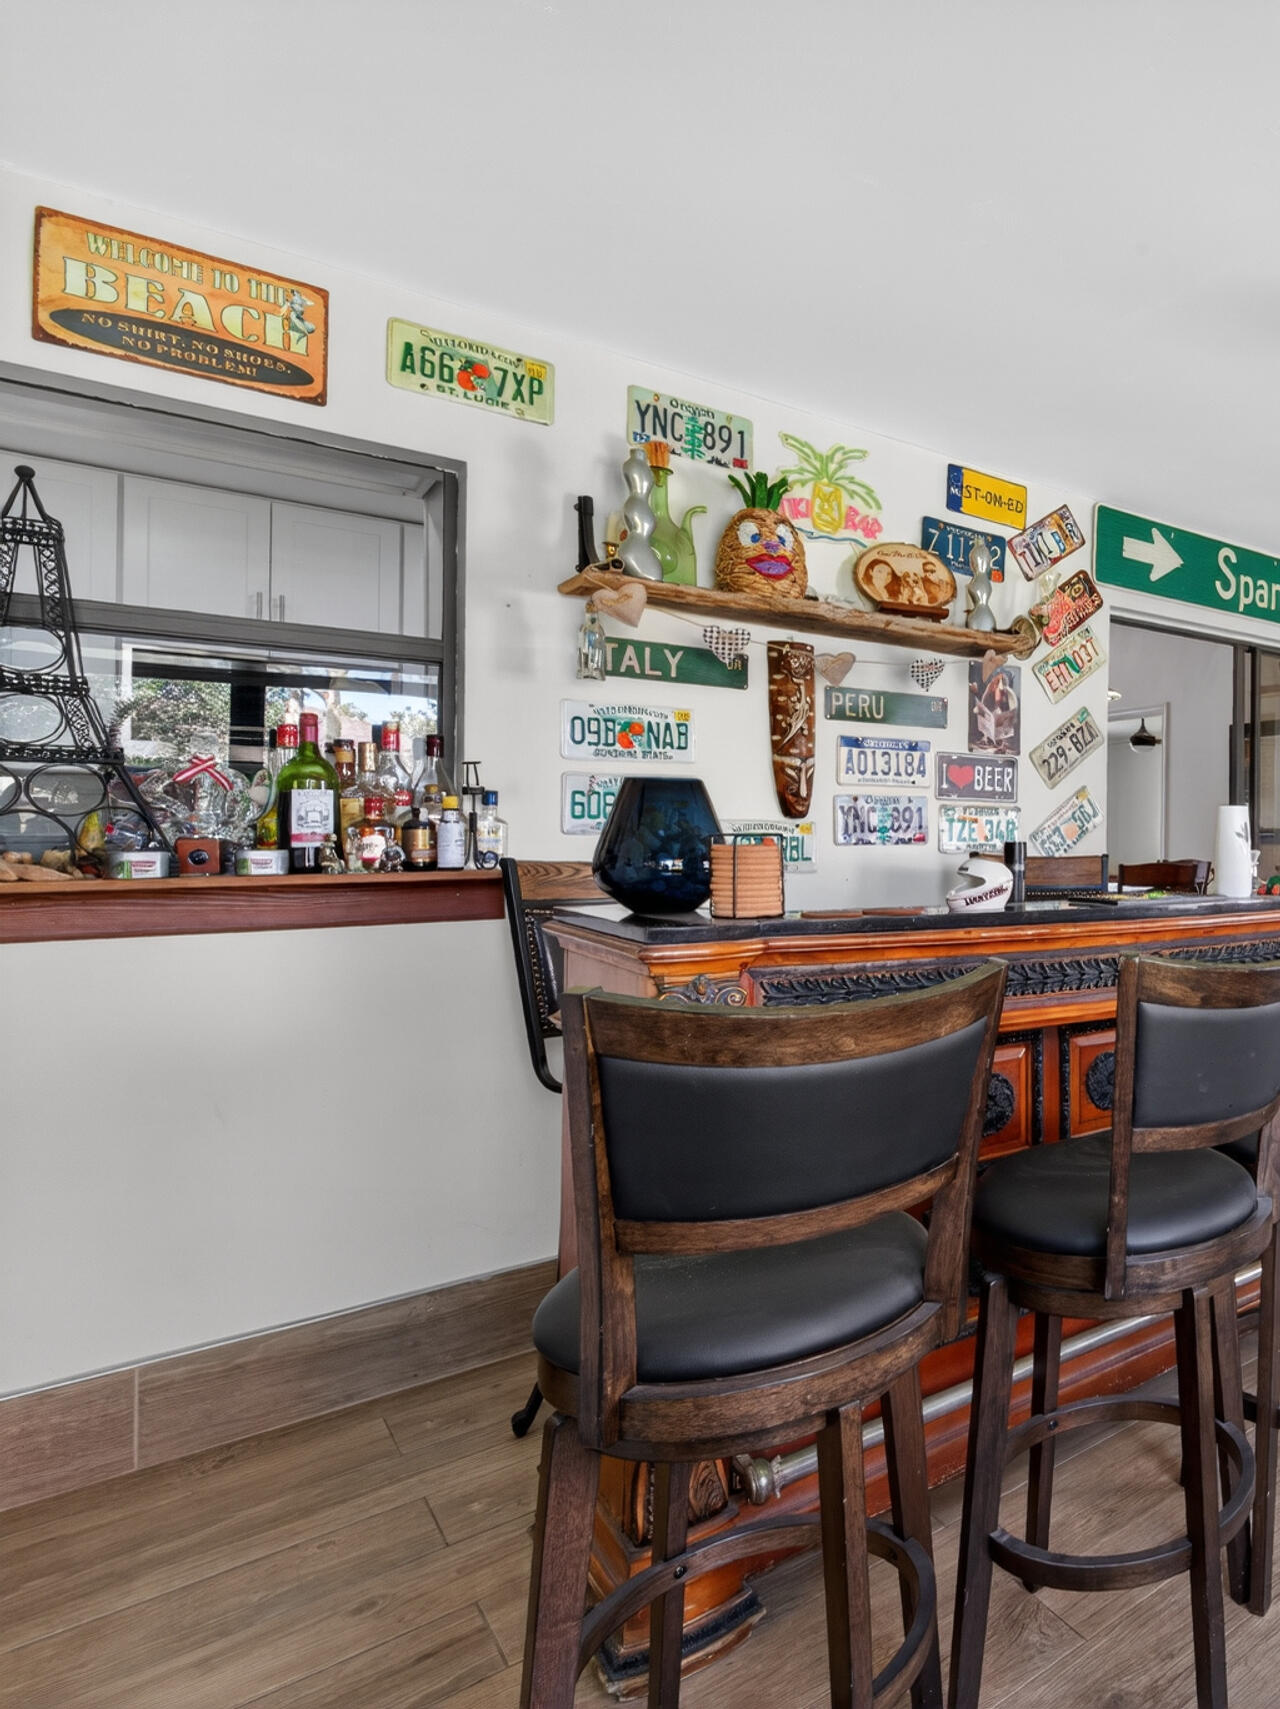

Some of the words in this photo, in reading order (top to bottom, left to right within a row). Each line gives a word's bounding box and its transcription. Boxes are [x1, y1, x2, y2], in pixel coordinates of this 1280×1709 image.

[86, 231, 203, 284] WELCOME
[212, 268, 240, 294] TO
[248, 278, 289, 307] THE
[62, 256, 310, 357] BEACH
[81, 312, 113, 328] NO
[192, 340, 219, 355] NO
[121, 335, 150, 350] NO
[400, 341, 454, 384] A66
[494, 366, 544, 406] 7XP
[463, 391, 510, 410] LUCIE
[635, 399, 684, 442] YNC
[702, 421, 745, 459] 891
[605, 642, 684, 678] TALY
[831, 691, 884, 719] PERU
[646, 719, 689, 750] NAB
[941, 763, 949, 789] I
[974, 765, 1013, 793] BEER
